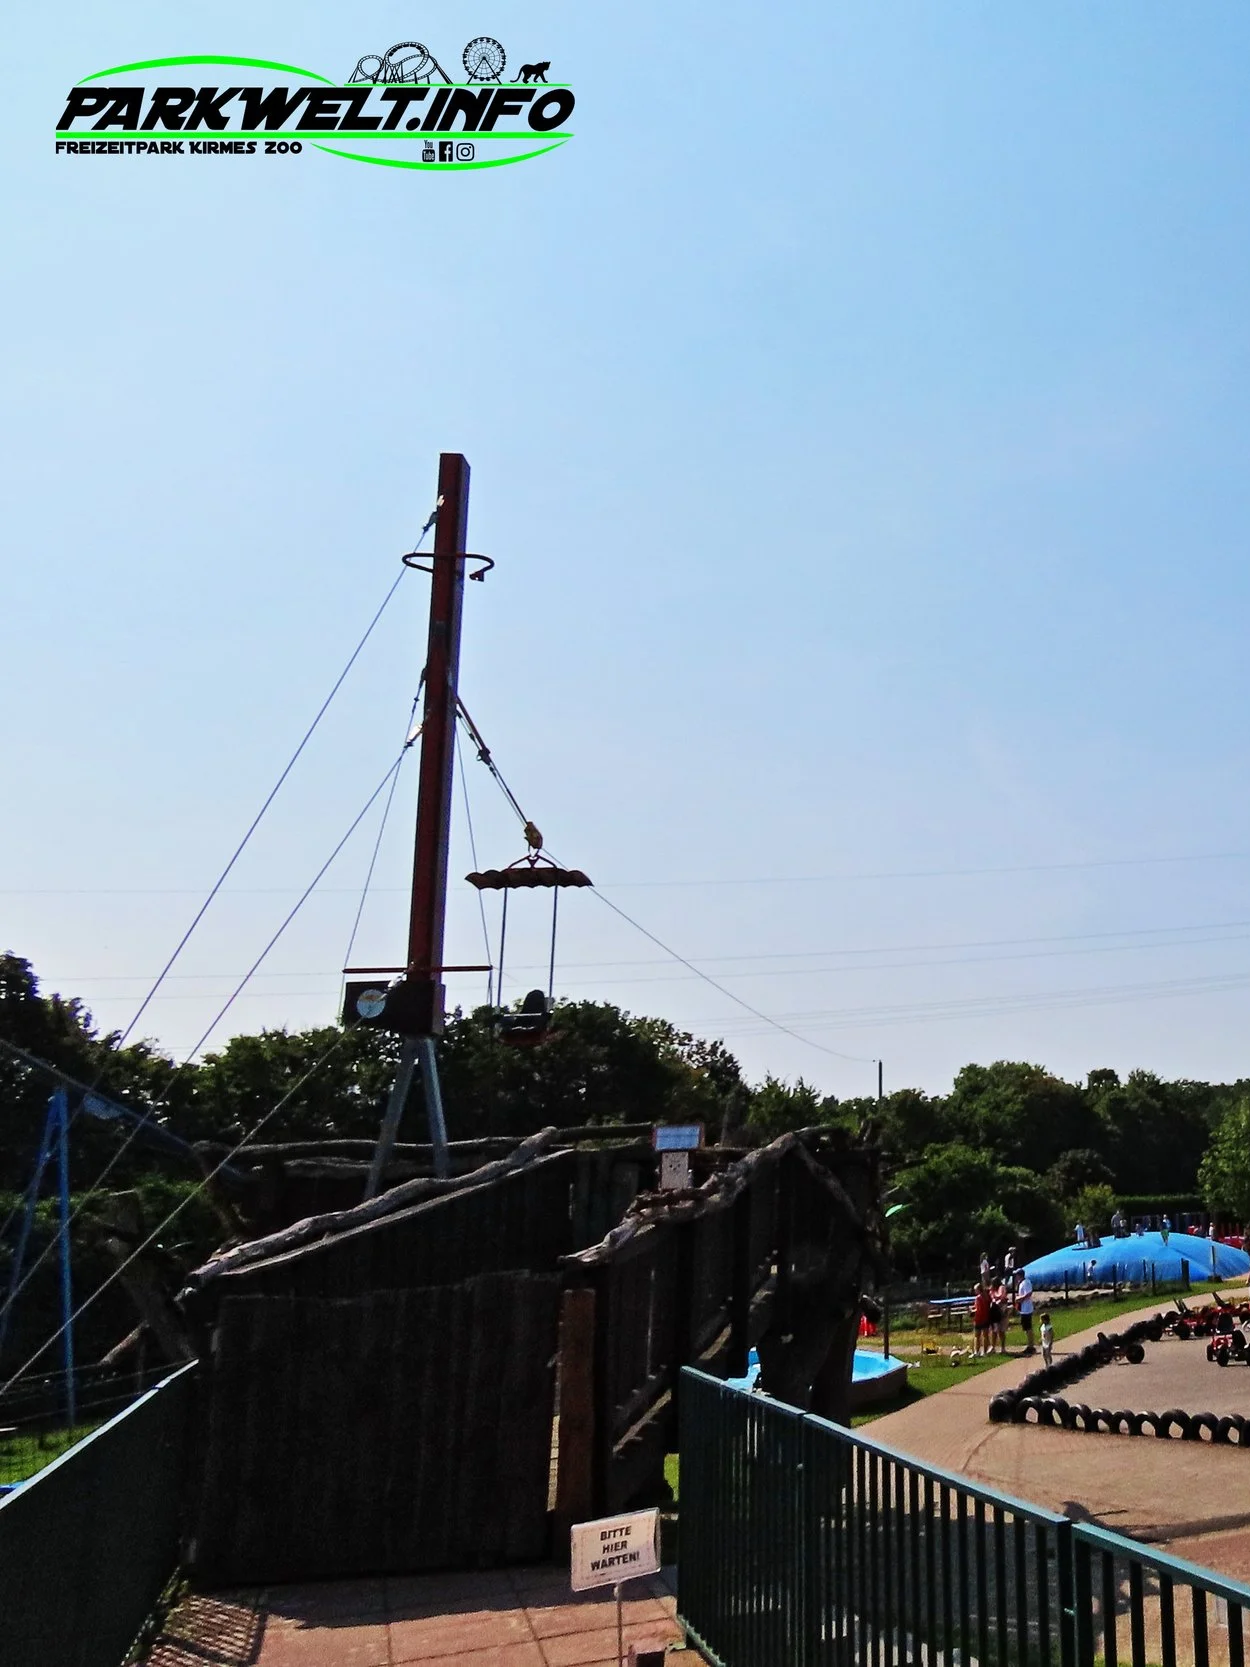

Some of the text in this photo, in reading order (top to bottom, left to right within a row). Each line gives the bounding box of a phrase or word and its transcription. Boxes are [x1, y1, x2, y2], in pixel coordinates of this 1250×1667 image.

[600, 1525, 632, 1541] BITTE
[602, 1540, 628, 1554] HIER
[590, 1551, 640, 1571] WARTEN!
